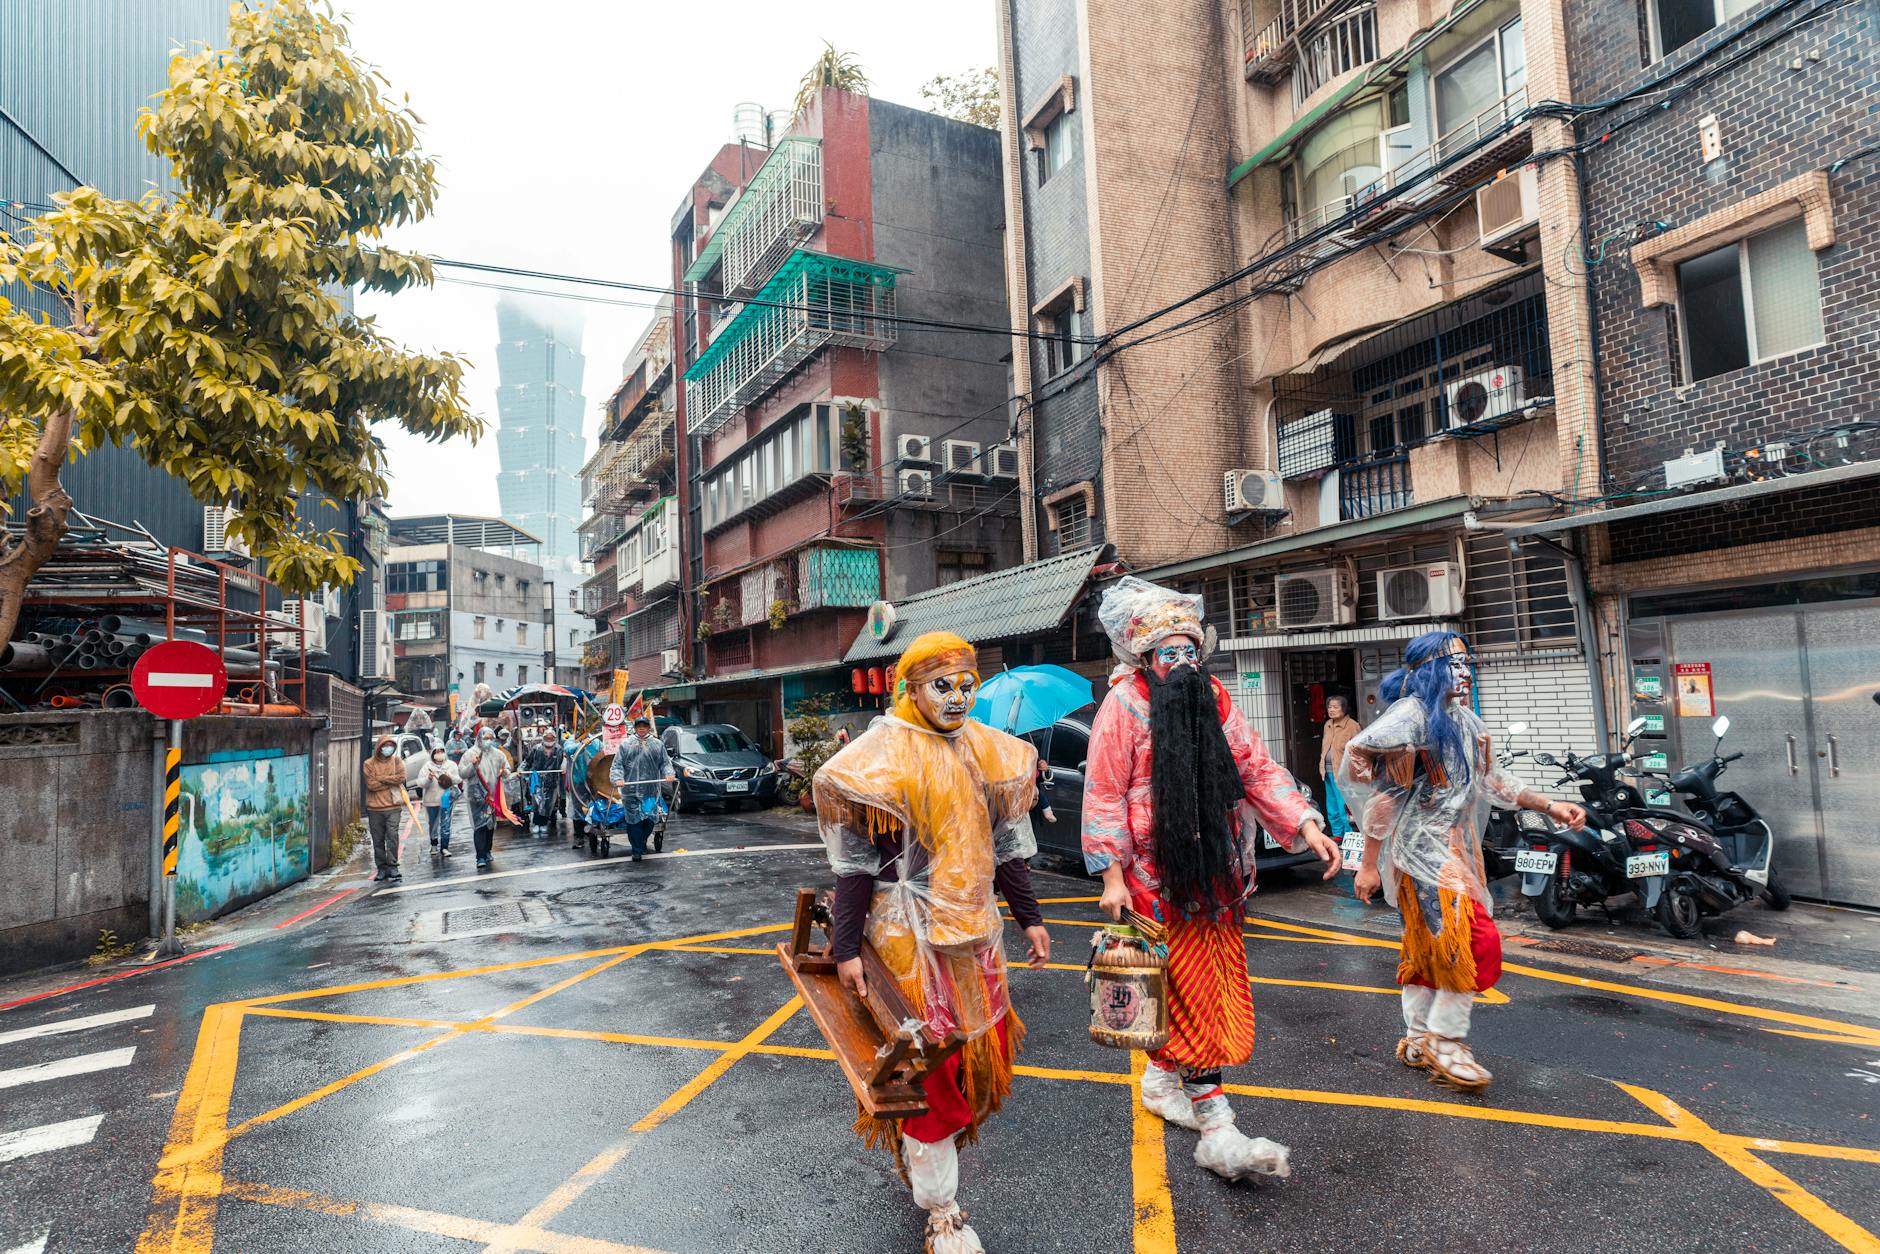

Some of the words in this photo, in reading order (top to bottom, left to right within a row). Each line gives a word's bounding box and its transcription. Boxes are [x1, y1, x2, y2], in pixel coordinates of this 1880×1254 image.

[607, 707, 622, 721] 29
[1516, 857, 1554, 871] 980-EPW
[1628, 860, 1666, 874] 393-NNY
